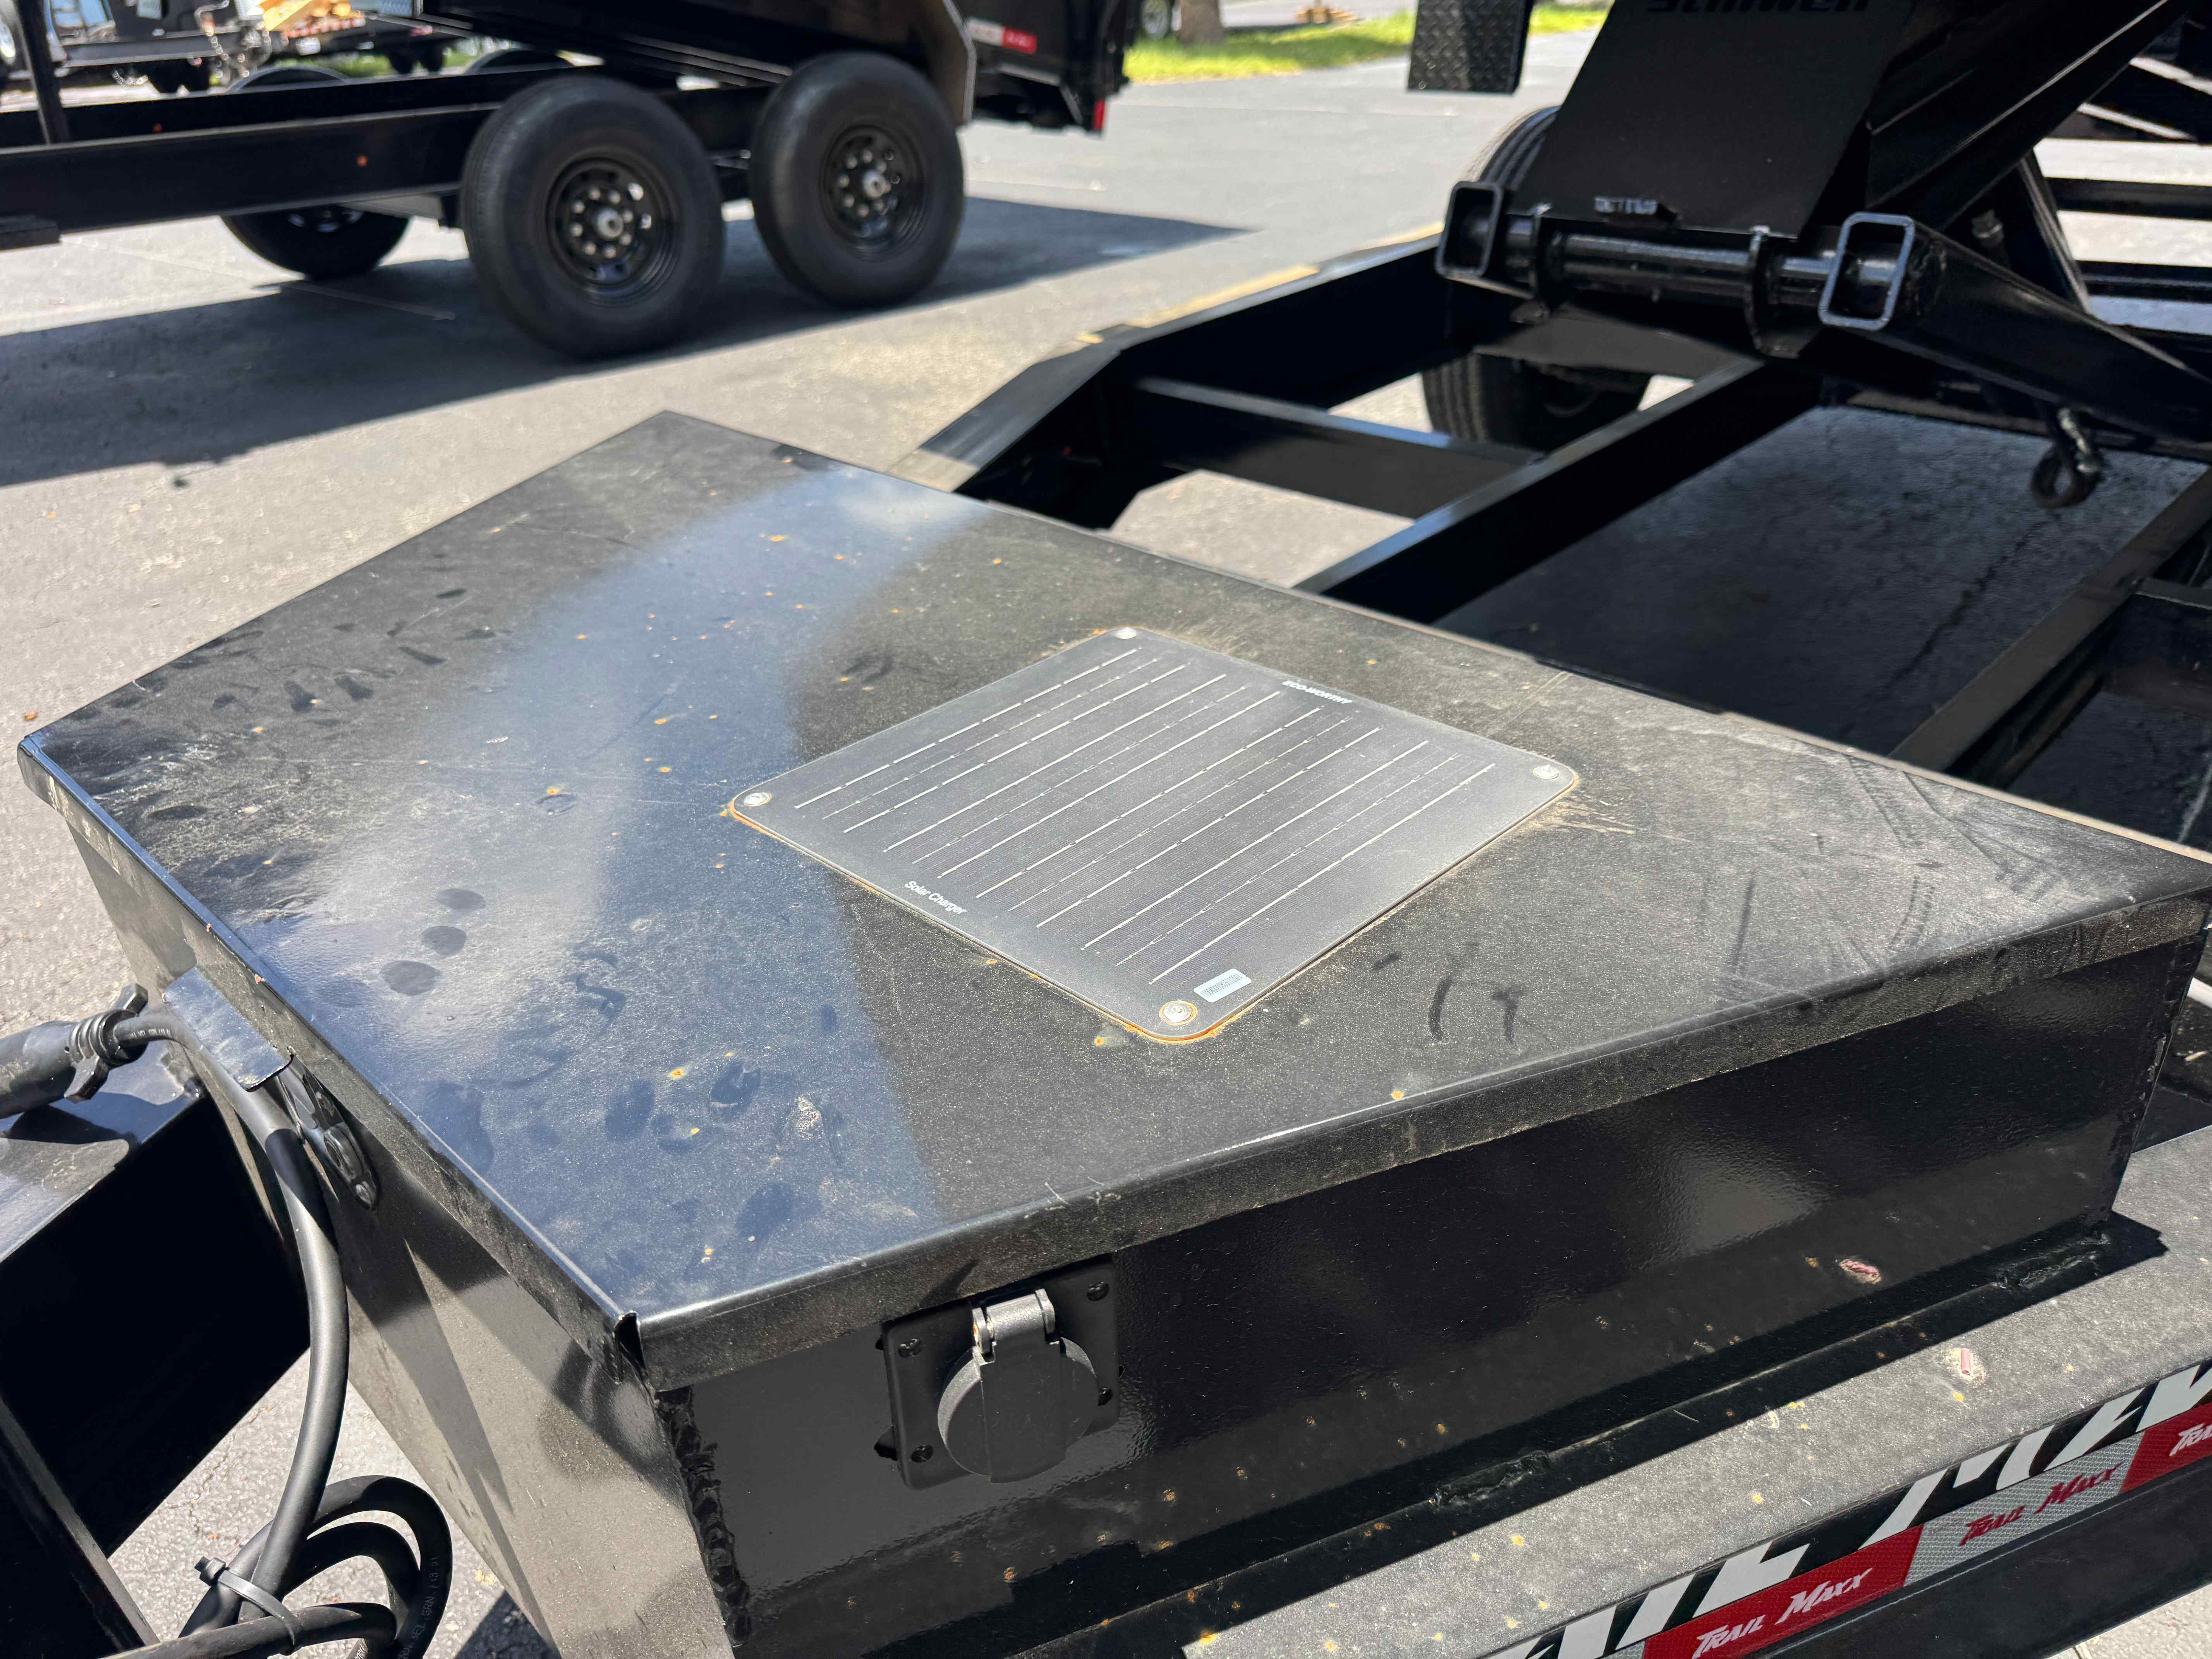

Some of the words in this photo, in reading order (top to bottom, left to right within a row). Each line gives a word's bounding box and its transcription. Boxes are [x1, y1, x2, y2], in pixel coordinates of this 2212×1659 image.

[1282, 680, 1353, 704] ECO-WORTHY
[905, 881, 931, 896] Solar
[928, 893, 967, 914] Charger
